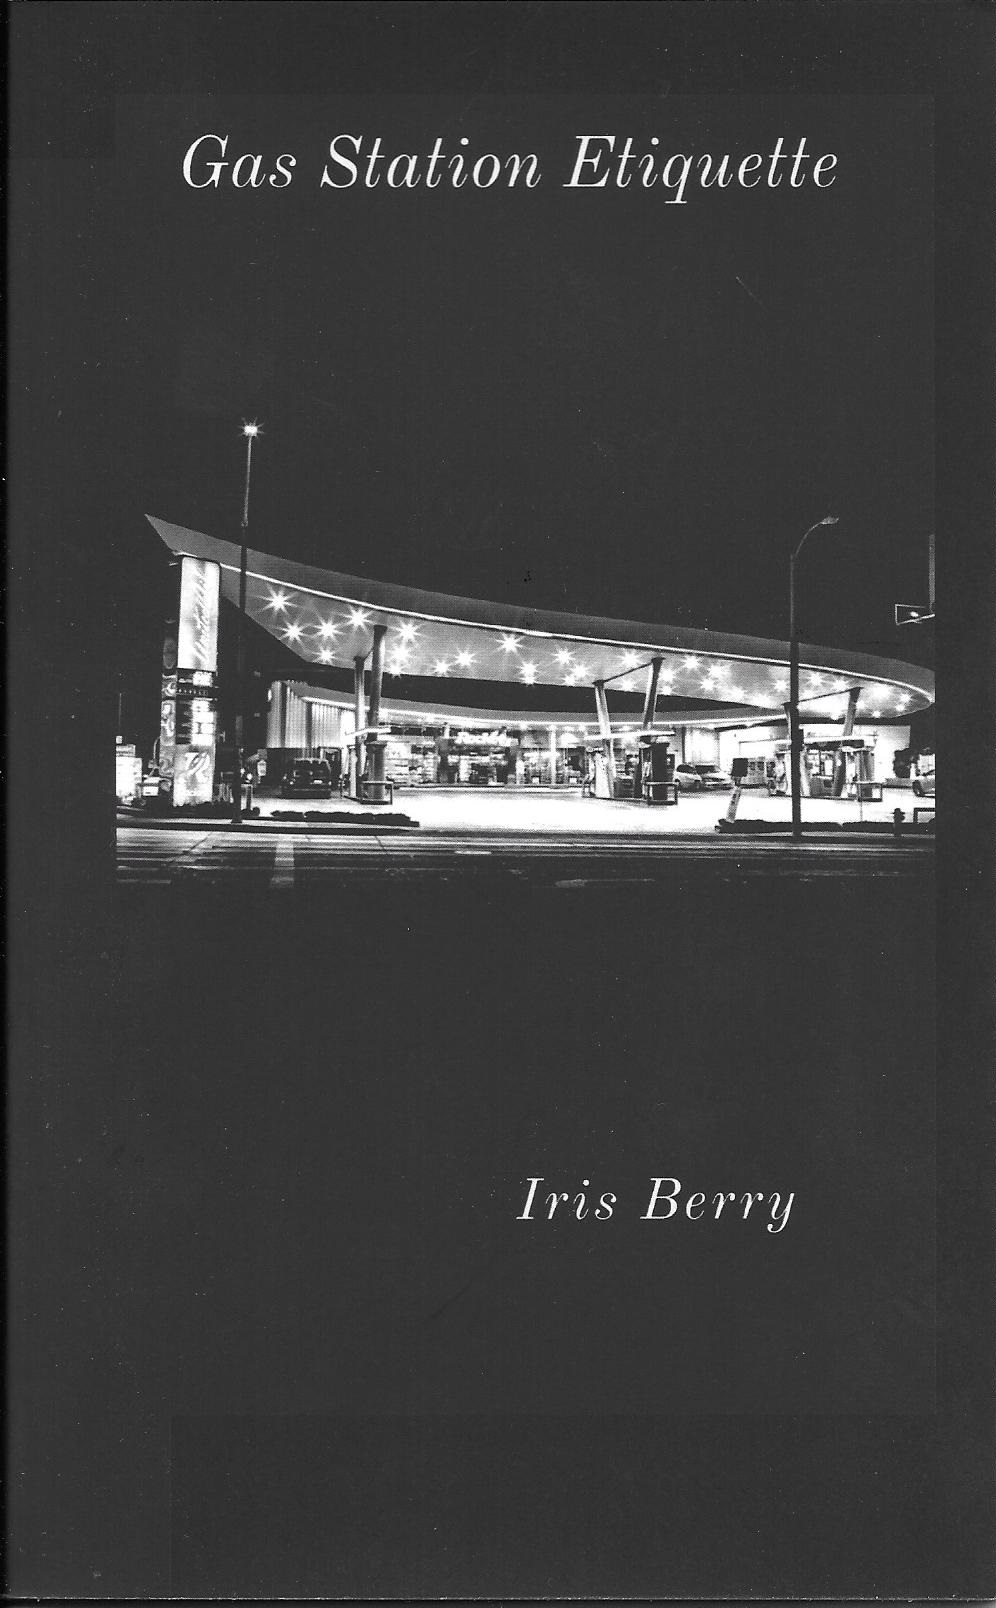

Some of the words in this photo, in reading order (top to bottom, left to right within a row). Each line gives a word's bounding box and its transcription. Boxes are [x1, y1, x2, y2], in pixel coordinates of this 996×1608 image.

[182, 133, 297, 189] Gas
[320, 134, 541, 189] Station
[563, 135, 838, 204] Etiquette
[515, 1177, 617, 1220] Iris
[640, 1177, 795, 1234] Berry
